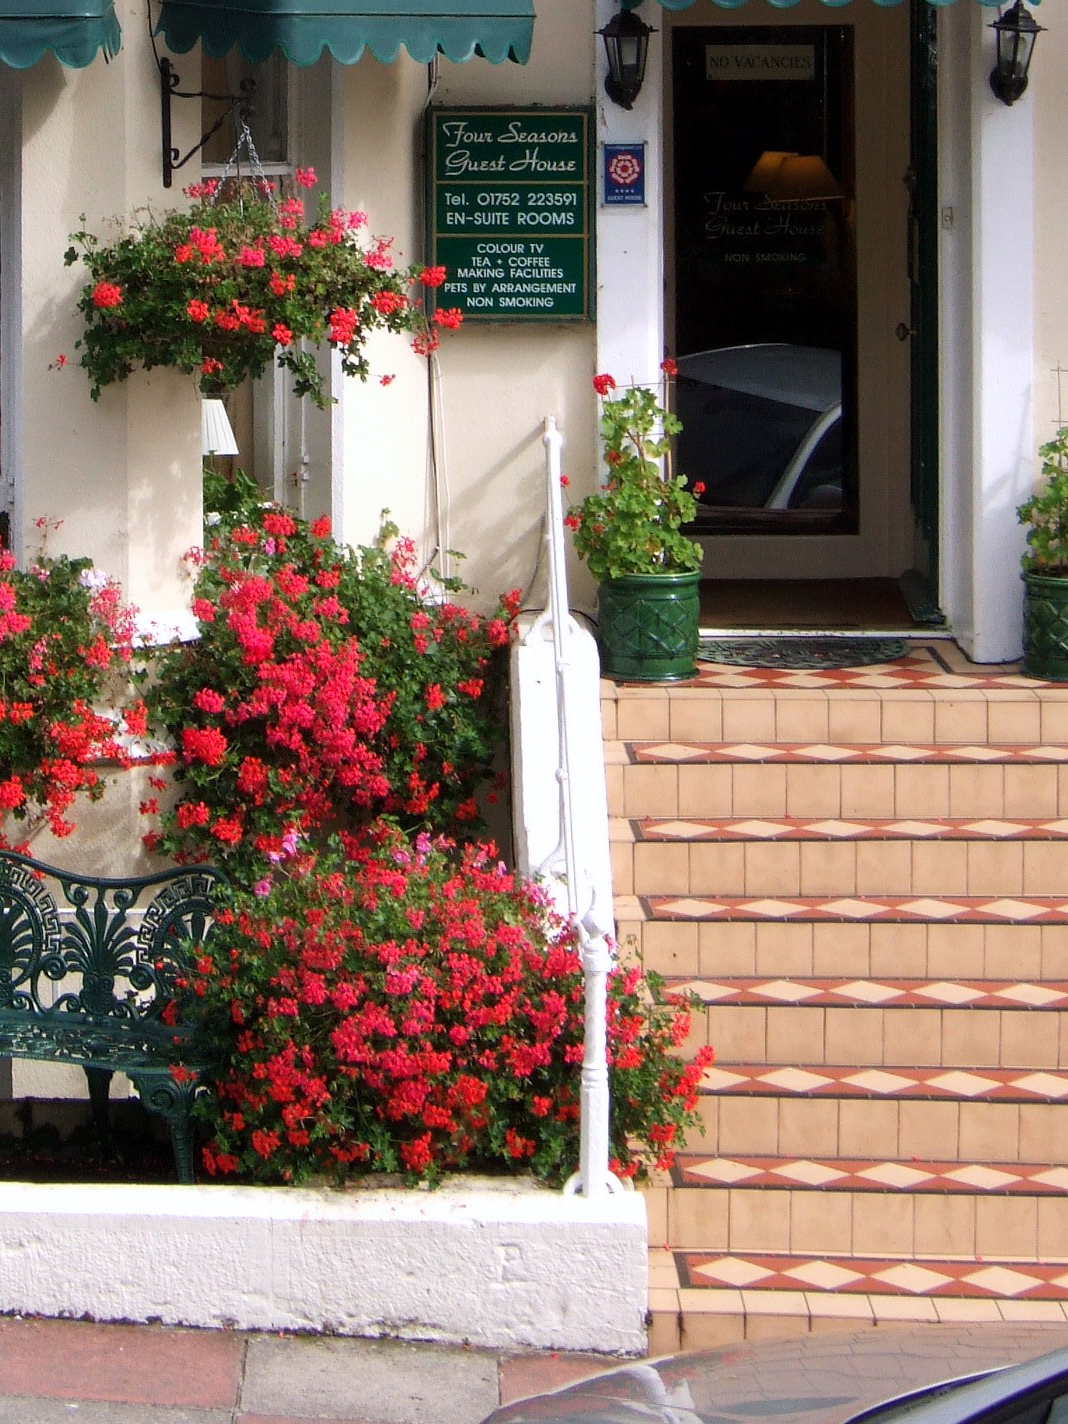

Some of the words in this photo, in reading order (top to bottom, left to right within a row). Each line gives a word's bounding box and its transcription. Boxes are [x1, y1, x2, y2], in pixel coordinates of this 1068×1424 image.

[709, 56, 730, 69] NO
[734, 55, 812, 69] VACANCIES
[442, 121, 493, 147] Four
[497, 121, 579, 143] Seasons
[444, 149, 506, 176] Guest
[509, 147, 577, 172] House
[444, 193, 469, 206] Tel.
[477, 192, 520, 206] 01752
[527, 192, 577, 206] 223591
[446, 212, 509, 225] EN-SUITE
[517, 212, 575, 225] ROOMS
[477, 243, 524, 254] COLOUR
[529, 244, 544, 254] TV
[472, 257, 491, 267] TEA
[508, 257, 550, 267] COFFEE
[457, 268, 505, 278] MAKING
[510, 268, 564, 278] FACILITIES
[444, 283, 468, 293] PETS
[473, 283, 486, 293] BY
[492, 283, 577, 293] ARRANGEMENT
[467, 297, 493, 307] NON
[499, 297, 554, 307] SMOKING
